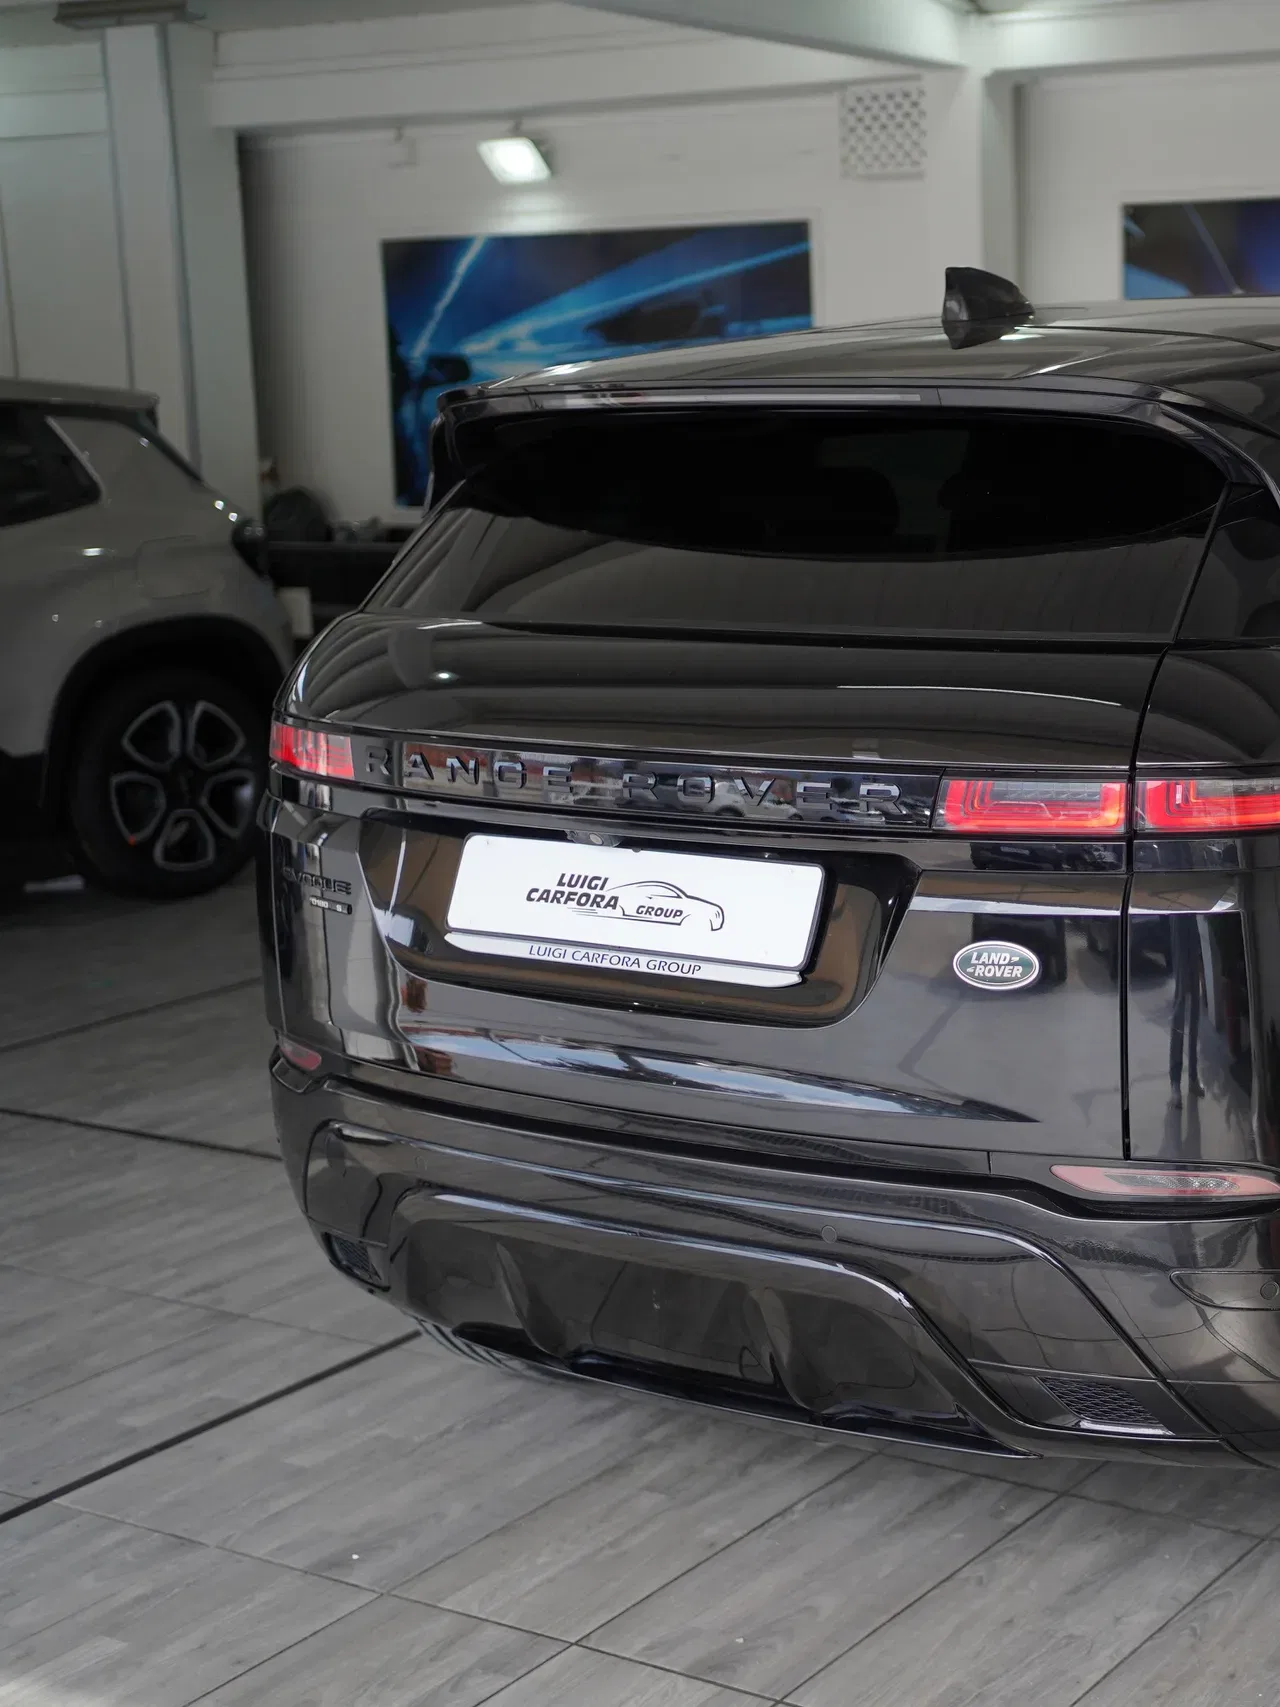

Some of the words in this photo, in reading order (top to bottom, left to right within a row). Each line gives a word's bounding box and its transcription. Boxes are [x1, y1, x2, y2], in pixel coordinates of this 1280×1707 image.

[362, 743, 575, 794] RANGE
[622, 770, 909, 817] ROVER
[556, 872, 609, 891] LUIGI
[525, 887, 619, 911] CARFORA
[635, 904, 684, 920] GROUP
[528, 944, 568, 961] LUIGI
[571, 949, 641, 970] CARFORA
[645, 959, 702, 976] GROUP
[970, 951, 1010, 965] LAND
[974, 965, 1023, 978] ROVER
